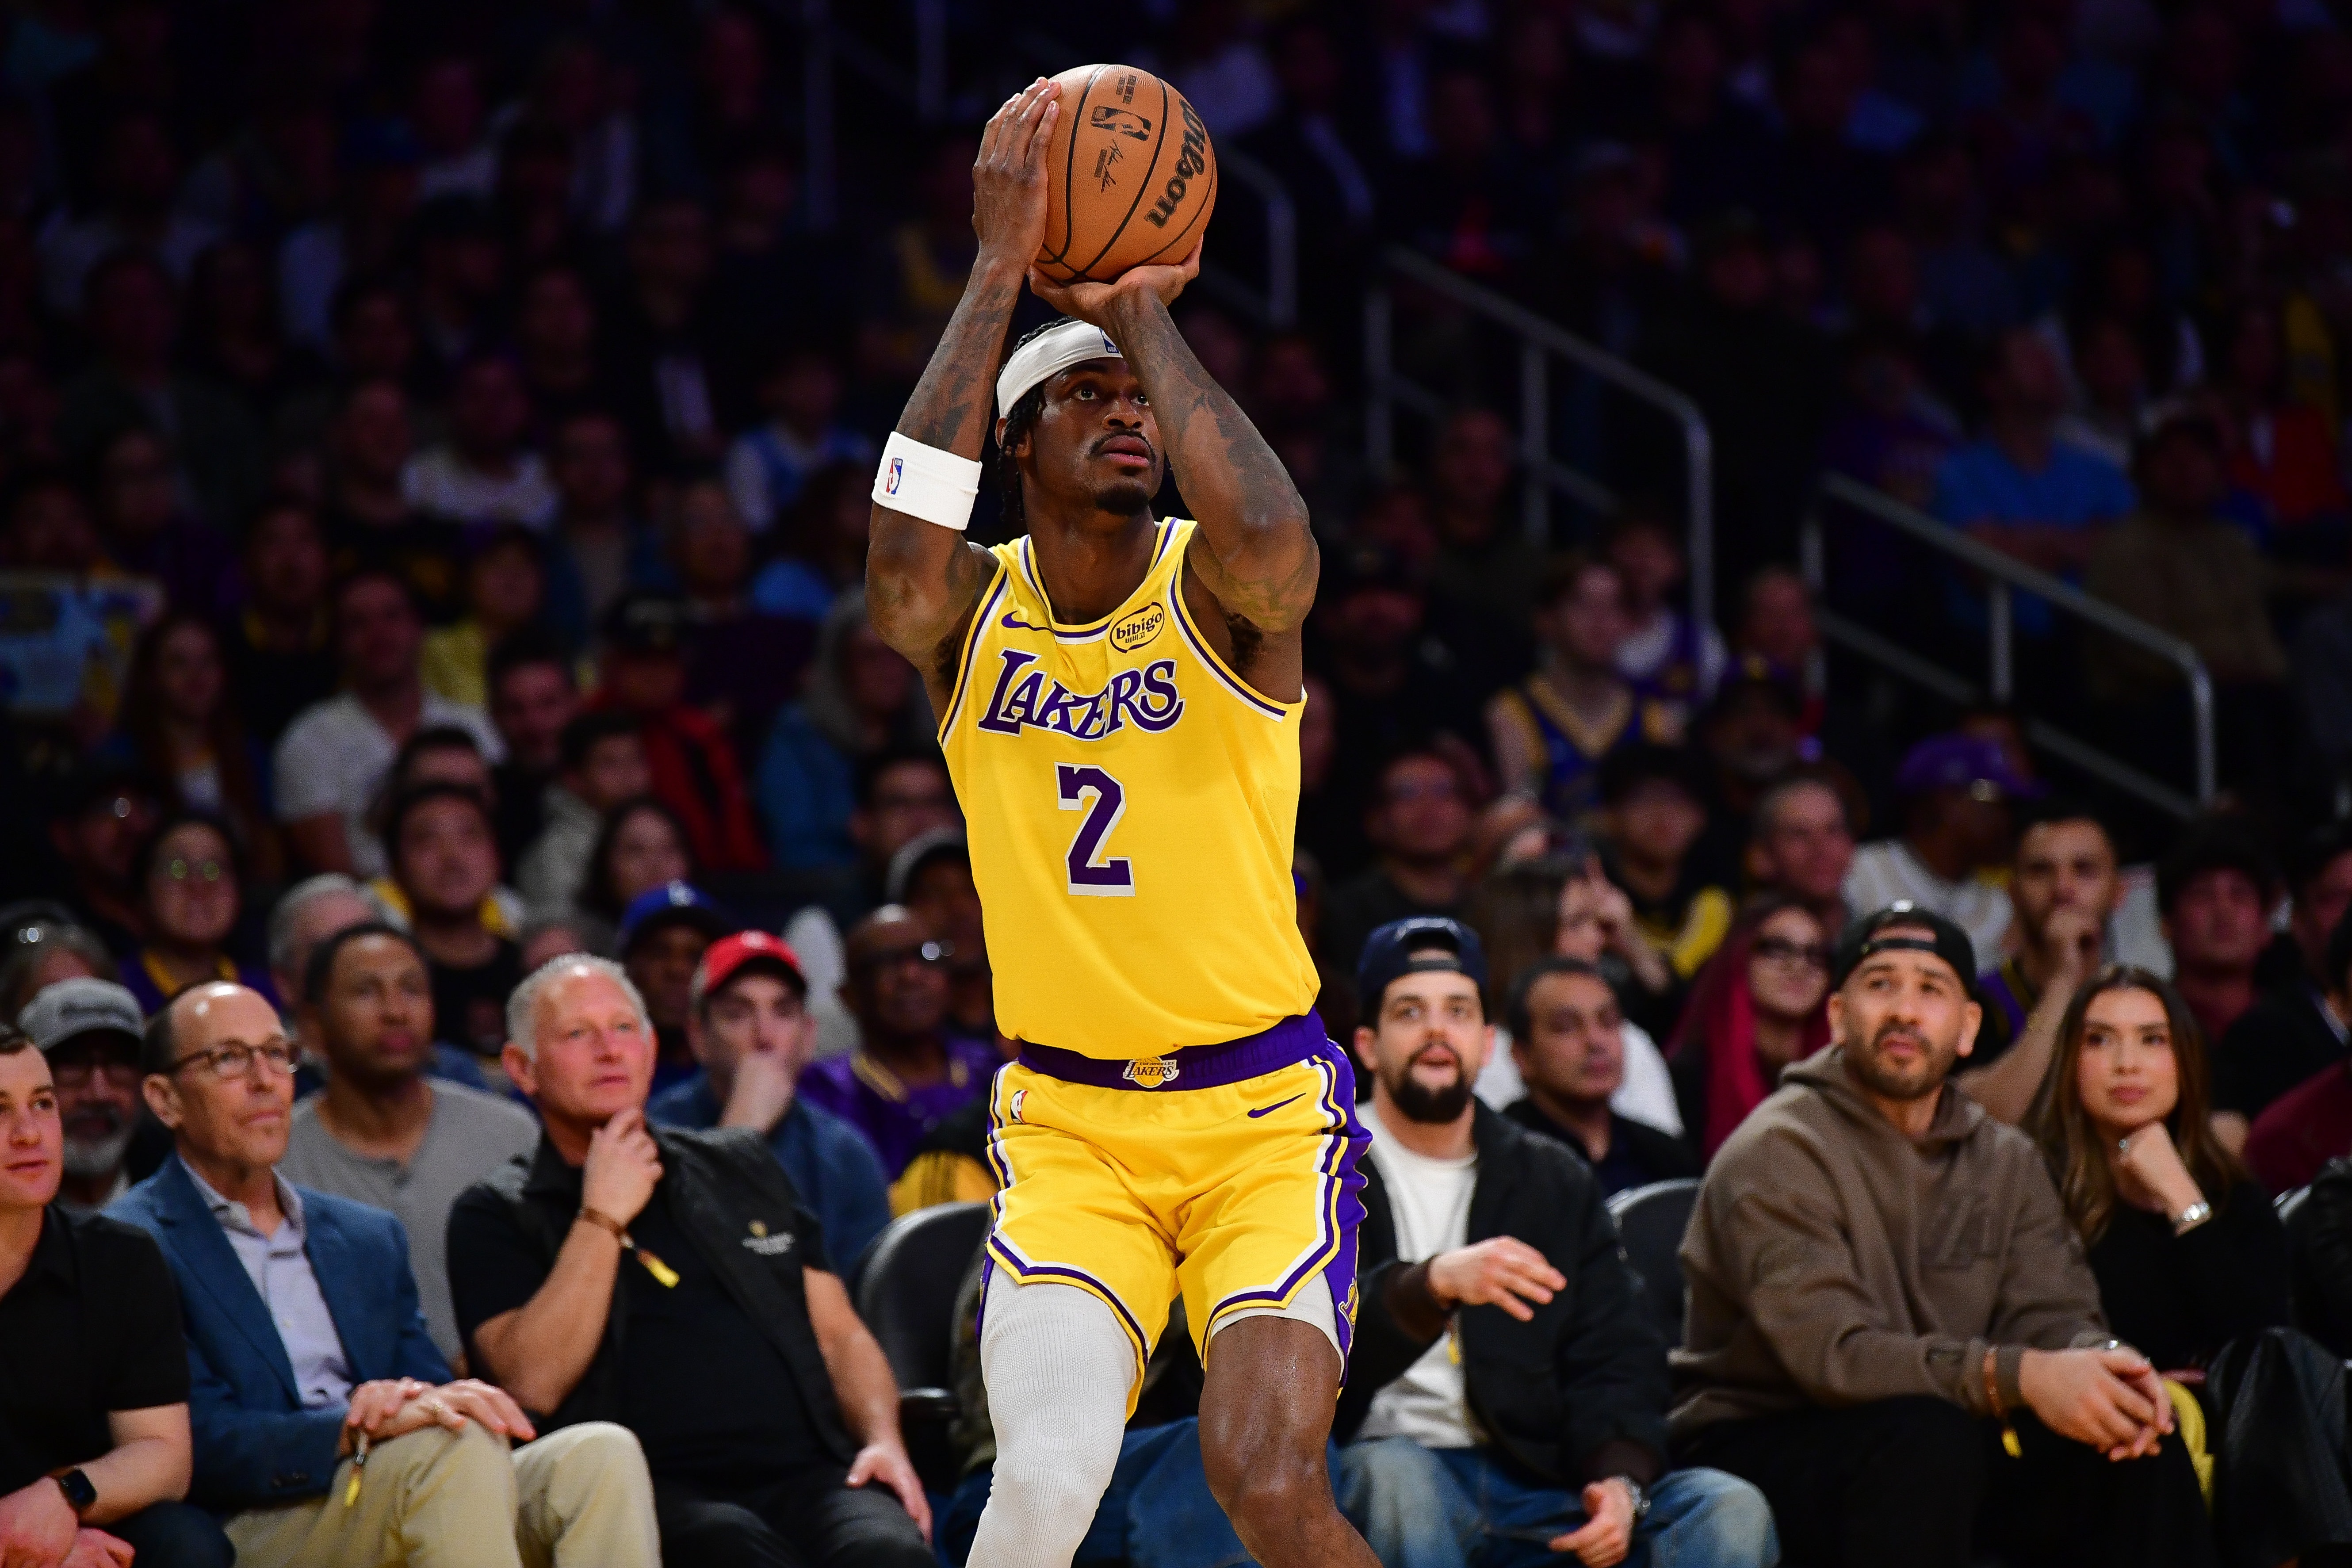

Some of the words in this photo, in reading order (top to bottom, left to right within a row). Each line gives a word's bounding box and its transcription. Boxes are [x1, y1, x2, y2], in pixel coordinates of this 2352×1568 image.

[1144, 99, 1206, 228] Wilson
[1116, 612, 1162, 640] bibigo
[1125, 631, 1146, 644] 비비고
[977, 647, 1186, 742] LAKERS
[1054, 761, 1136, 897] 2
[1124, 1061, 1179, 1080] LAKERS
